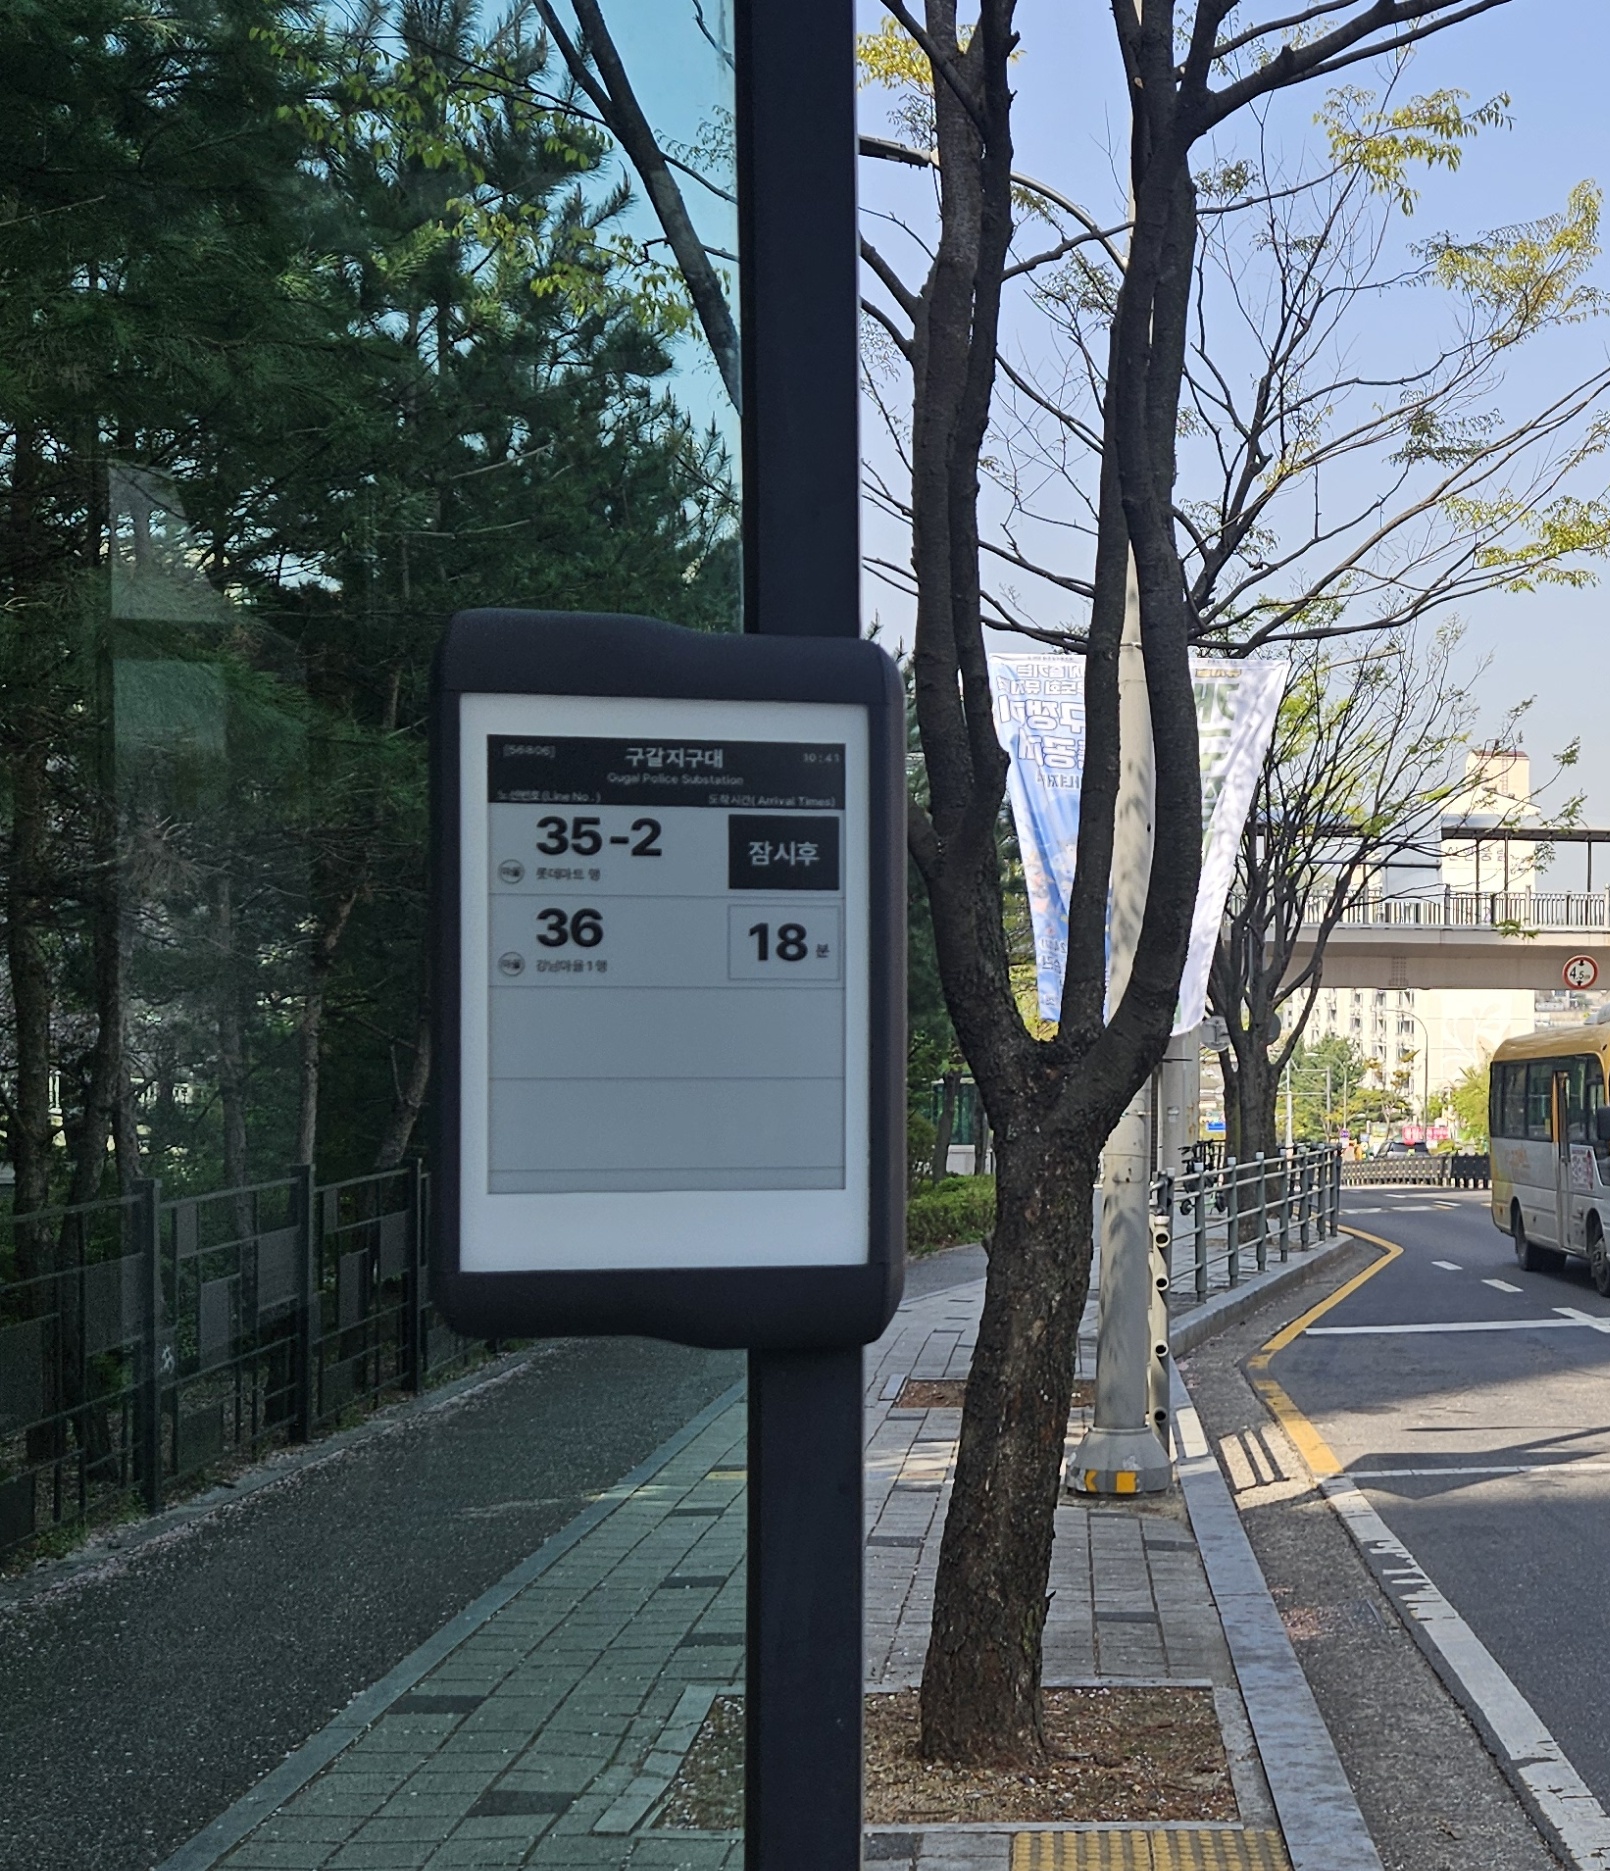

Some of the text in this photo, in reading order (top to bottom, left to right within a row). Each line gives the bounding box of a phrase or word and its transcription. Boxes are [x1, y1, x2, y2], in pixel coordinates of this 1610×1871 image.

[625, 747, 724, 768] 구갈지구대
[642, 773, 679, 785] Police
[681, 774, 744, 786] Substation
[536, 816, 663, 857] 35-2
[748, 841, 820, 867] 잠시후
[536, 908, 604, 948] 36
[748, 923, 809, 962] 18
